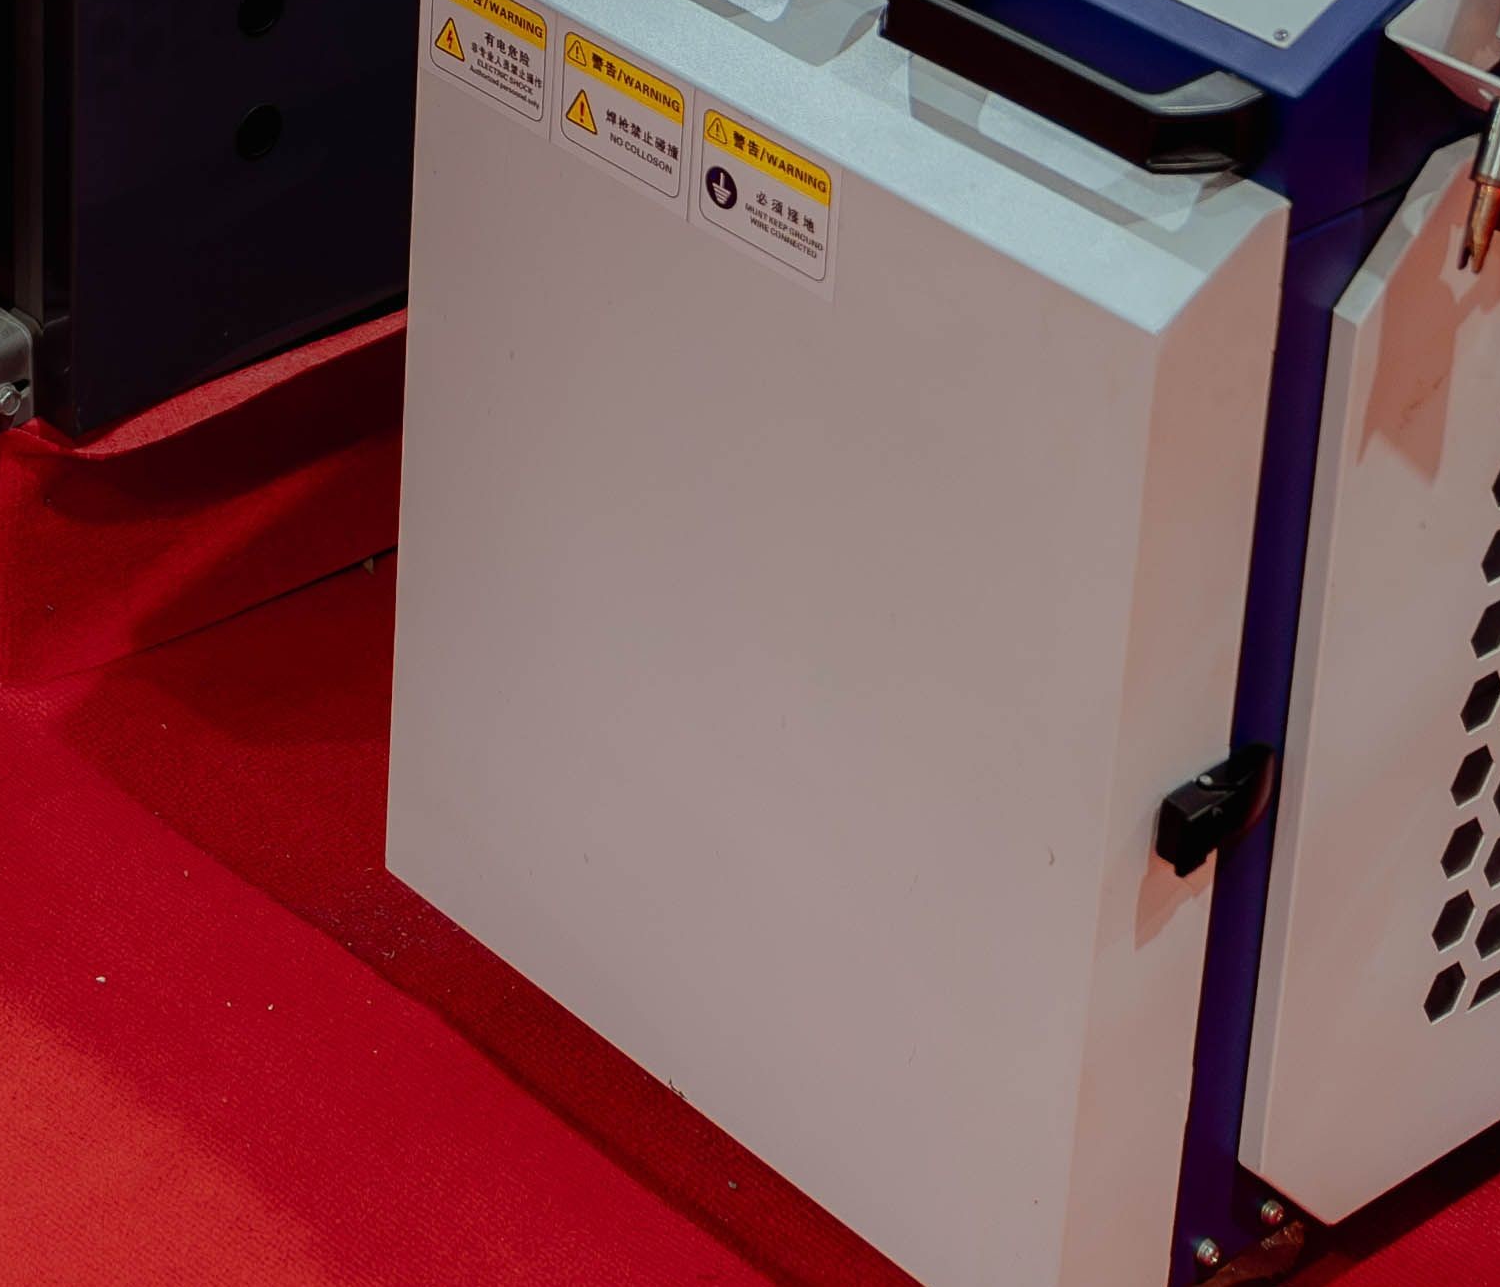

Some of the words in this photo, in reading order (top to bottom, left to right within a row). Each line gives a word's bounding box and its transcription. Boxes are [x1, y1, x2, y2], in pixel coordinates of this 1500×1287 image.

[484, 31, 530, 68] 有电危险
[477, 58, 508, 82] ELECTRIC
[509, 75, 534, 96] SHOCK
[592, 52, 680, 113] 警告/WARNING
[610, 132, 623, 147] NO
[733, 130, 827, 193] 警告/WARNING
[750, 217, 769, 233] WIRE
[770, 227, 817, 259] CONNECTED
[768, 213, 789, 231] KEEP
[789, 224, 824, 252] GROUND
